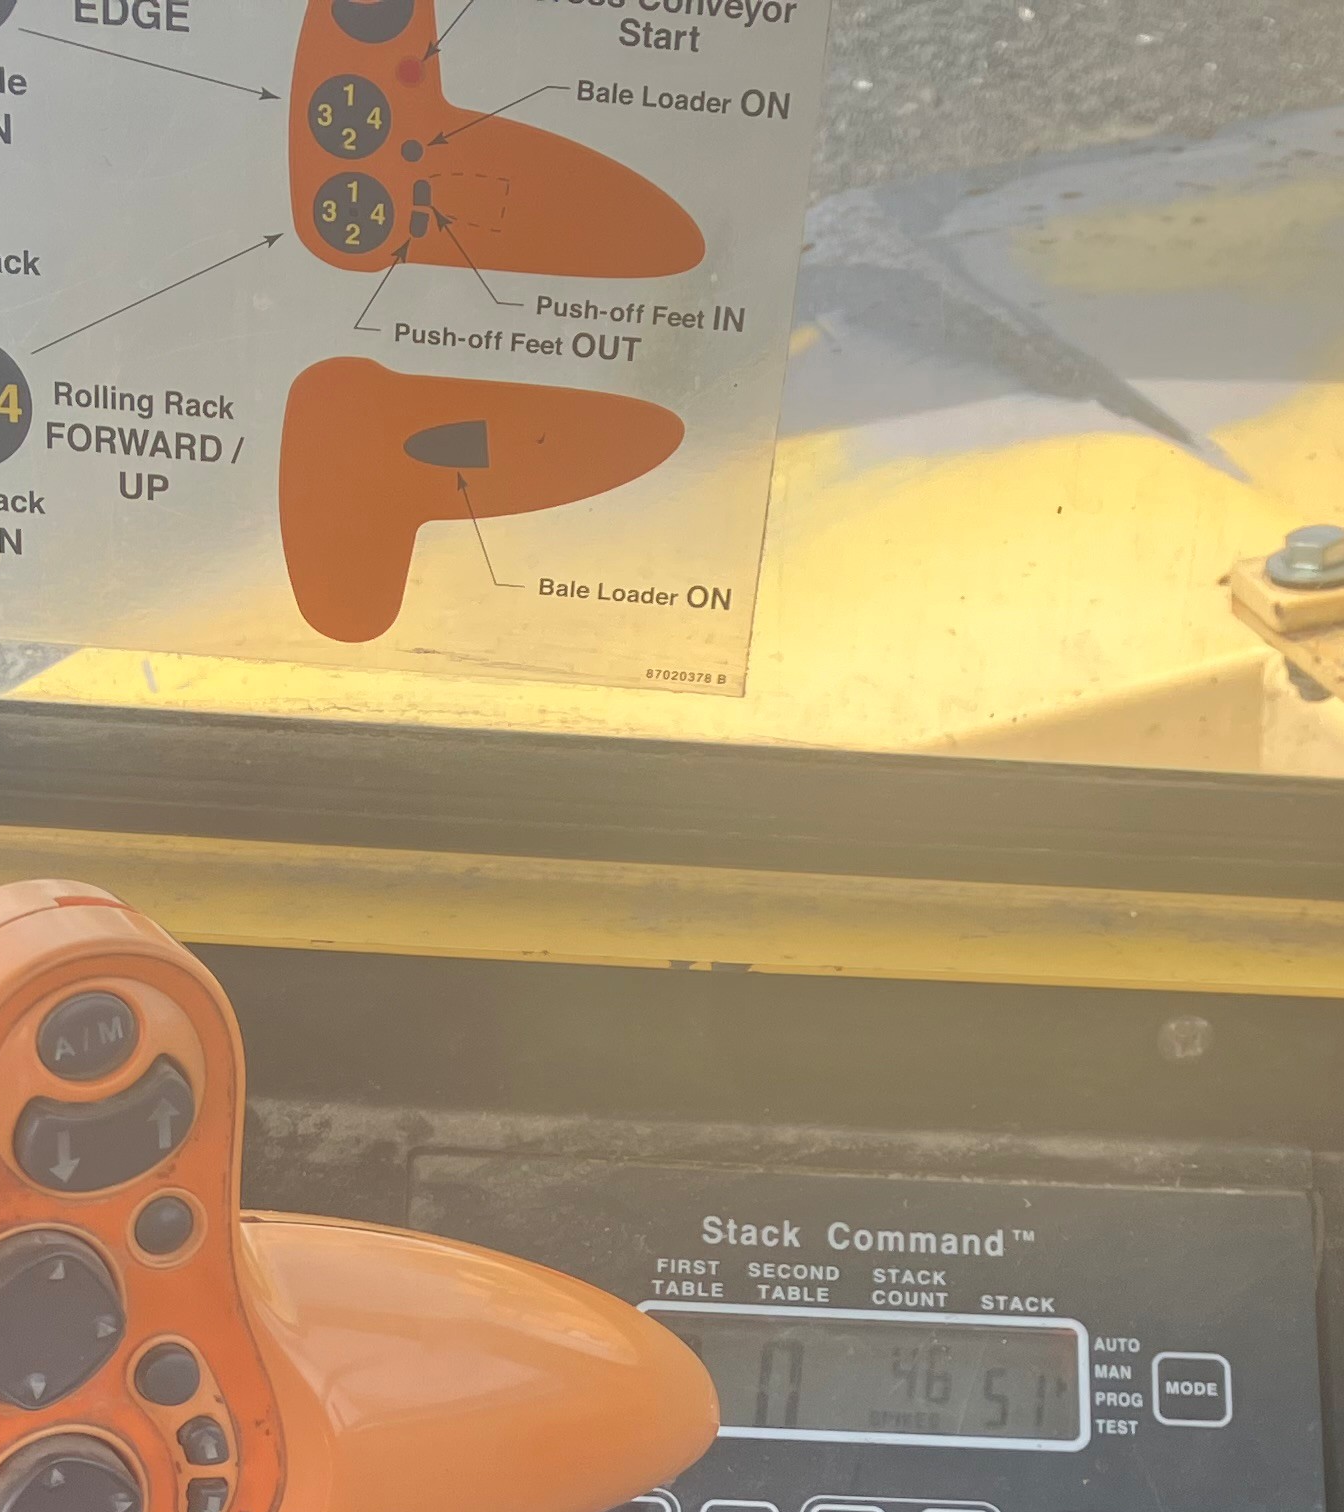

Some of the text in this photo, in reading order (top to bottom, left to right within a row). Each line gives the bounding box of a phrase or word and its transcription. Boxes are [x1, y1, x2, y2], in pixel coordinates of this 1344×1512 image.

[75, 0, 189, 32] EDGE
[619, 18, 700, 52] Start
[578, 80, 790, 119] Bale Loader ON
[537, 296, 745, 332] Push-off Feet IN
[395, 323, 642, 361] Push-off Feet OUT
[55, 382, 233, 419] Rolling Rack
[47, 422, 222, 462] FORWARD
[120, 472, 168, 500] UP
[539, 578, 731, 610] Bale Loader ON
[646, 669, 726, 684] 87020378 B
[703, 1216, 800, 1247] Stack
[657, 1259, 719, 1275] FIRST
[749, 1263, 839, 1280] SECOND
[873, 1268, 946, 1285] STACK
[652, 1280, 723, 1297] TABLE
[758, 1285, 829, 1302] TABLE
[872, 1290, 948, 1307] COUNT
[982, 1295, 1054, 1312] STACK
[1094, 1337, 1140, 1352] AUTO
[1095, 1365, 1131, 1379] MAN
[1166, 1381, 1217, 1396] MODE
[1095, 1392, 1143, 1407] PROG
[1096, 1419, 1138, 1434] TEST
